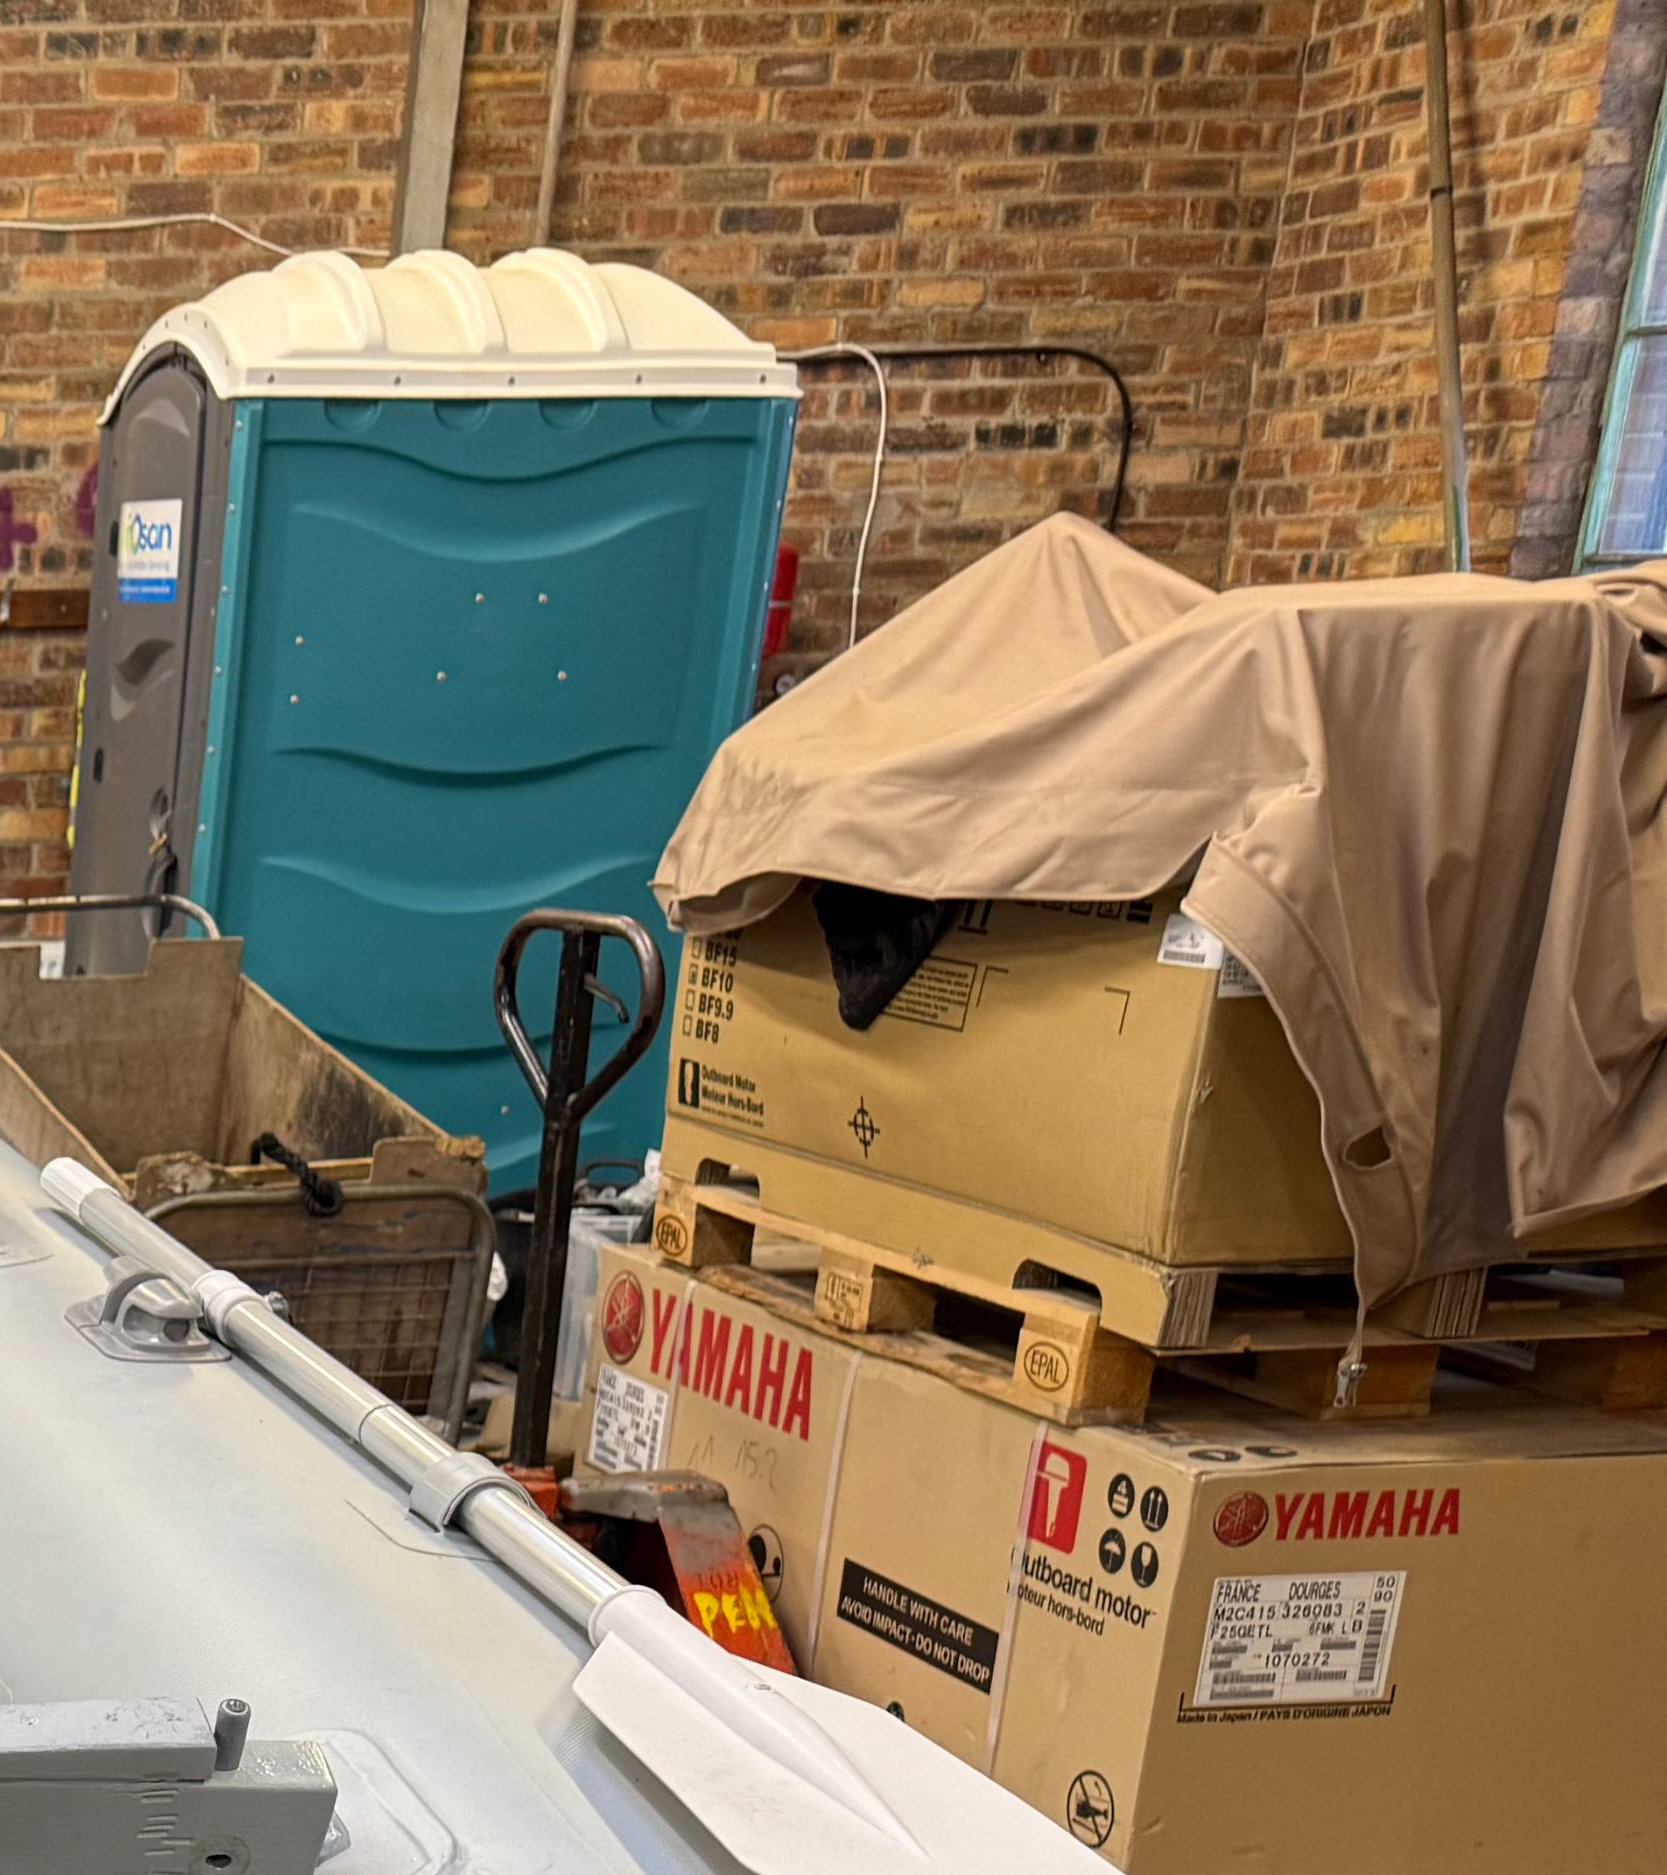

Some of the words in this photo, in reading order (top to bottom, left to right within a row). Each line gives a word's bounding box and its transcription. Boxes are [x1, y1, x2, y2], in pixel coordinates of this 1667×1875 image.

[705, 940, 737, 968] BF15
[701, 967, 734, 993] BF10
[698, 993, 734, 1021] BF9.9
[696, 1018, 719, 1044] BF8
[660, 1223, 681, 1249] EPAL
[651, 1288, 812, 1441] YAMAHA
[1029, 1350, 1061, 1384] EPAL
[1275, 1488, 1460, 1541] YAMAHA
[1217, 1583, 1261, 1602] FRANCE
[1289, 1581, 1341, 1600] DOURGES
[863, 1576, 908, 1611] HANDLE
[910, 1598, 939, 1628] WITH
[940, 1614, 973, 1647] CARE
[1007, 1580, 1046, 1608] oteur
[1047, 1592, 1105, 1636] hors-bord
[1095, 1587, 1152, 1629] motor
[841, 1597, 871, 1625] AVOID
[933, 1643, 956, 1669] NOT
[957, 1654, 989, 1685] DROP
[1265, 1653, 1330, 1667] 1070272
